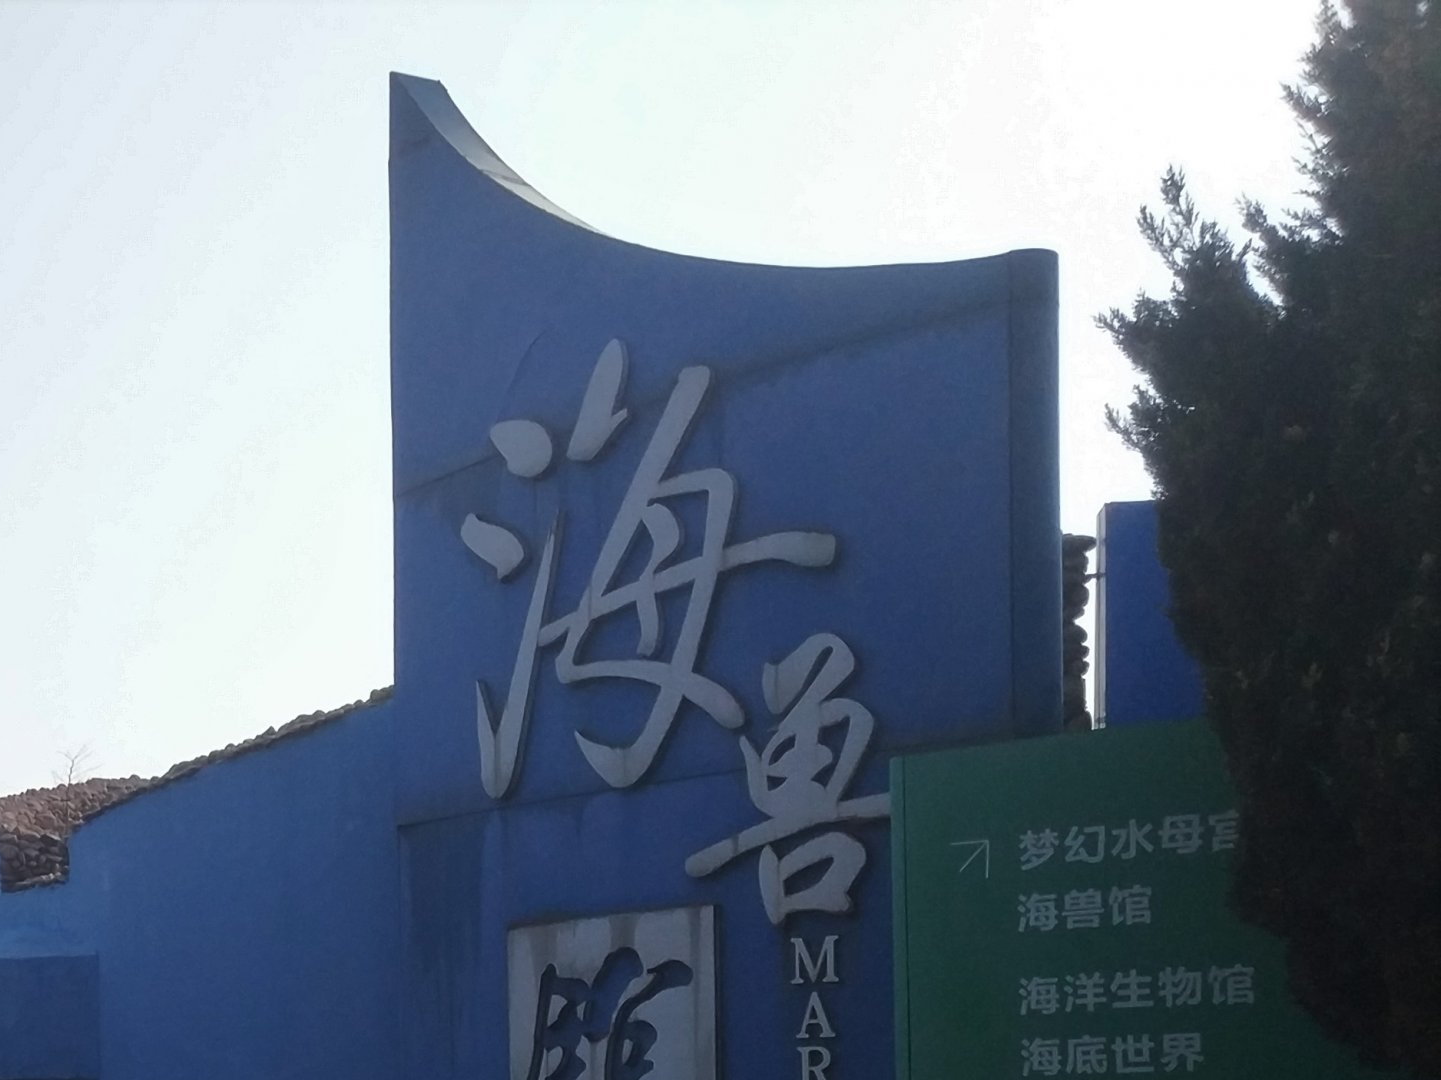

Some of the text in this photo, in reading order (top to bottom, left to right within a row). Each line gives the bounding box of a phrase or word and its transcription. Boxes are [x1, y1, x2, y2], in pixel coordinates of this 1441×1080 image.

[1017, 885, 1153, 933] 海兽馆
[1018, 963, 1256, 1016] 海洋生物馆
[1021, 1032, 1204, 1077] 海底世界
